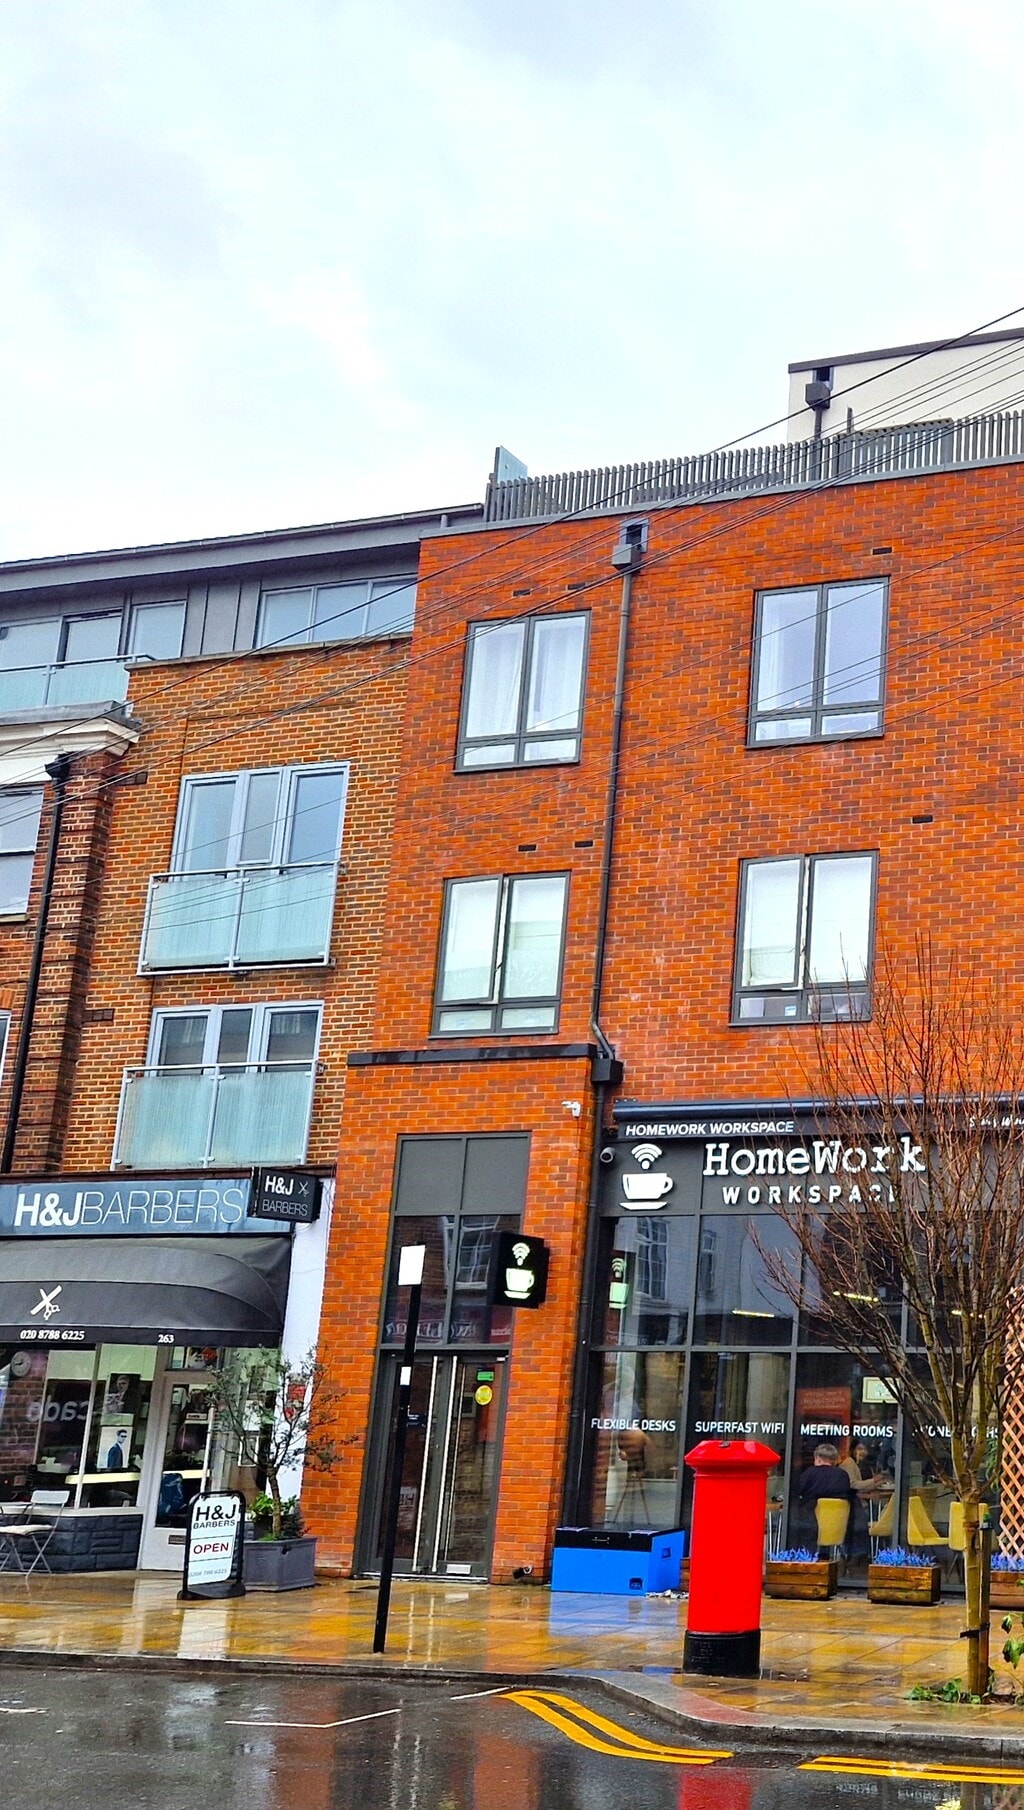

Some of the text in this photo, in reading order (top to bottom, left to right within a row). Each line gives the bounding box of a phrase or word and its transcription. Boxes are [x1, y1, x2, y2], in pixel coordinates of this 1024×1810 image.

[626, 1121, 795, 1136] HOMEWORK WORKSPACE
[703, 1136, 926, 1176] HomeWork
[265, 1175, 294, 1196] H&J
[262, 1199, 308, 1217] BARBERS
[20, 1330, 85, 1340] 020 8788 6225
[158, 1334, 175, 1343] 263
[591, 1418, 677, 1432] FLEXIBLE DESKS
[695, 1421, 785, 1434] SUPERFAST WIFI
[800, 1423, 894, 1438] MEETING ROOMS
[195, 1504, 237, 1521] H&J
[193, 1520, 236, 1529] BARBERS
[193, 1542, 229, 1554] OPEN
